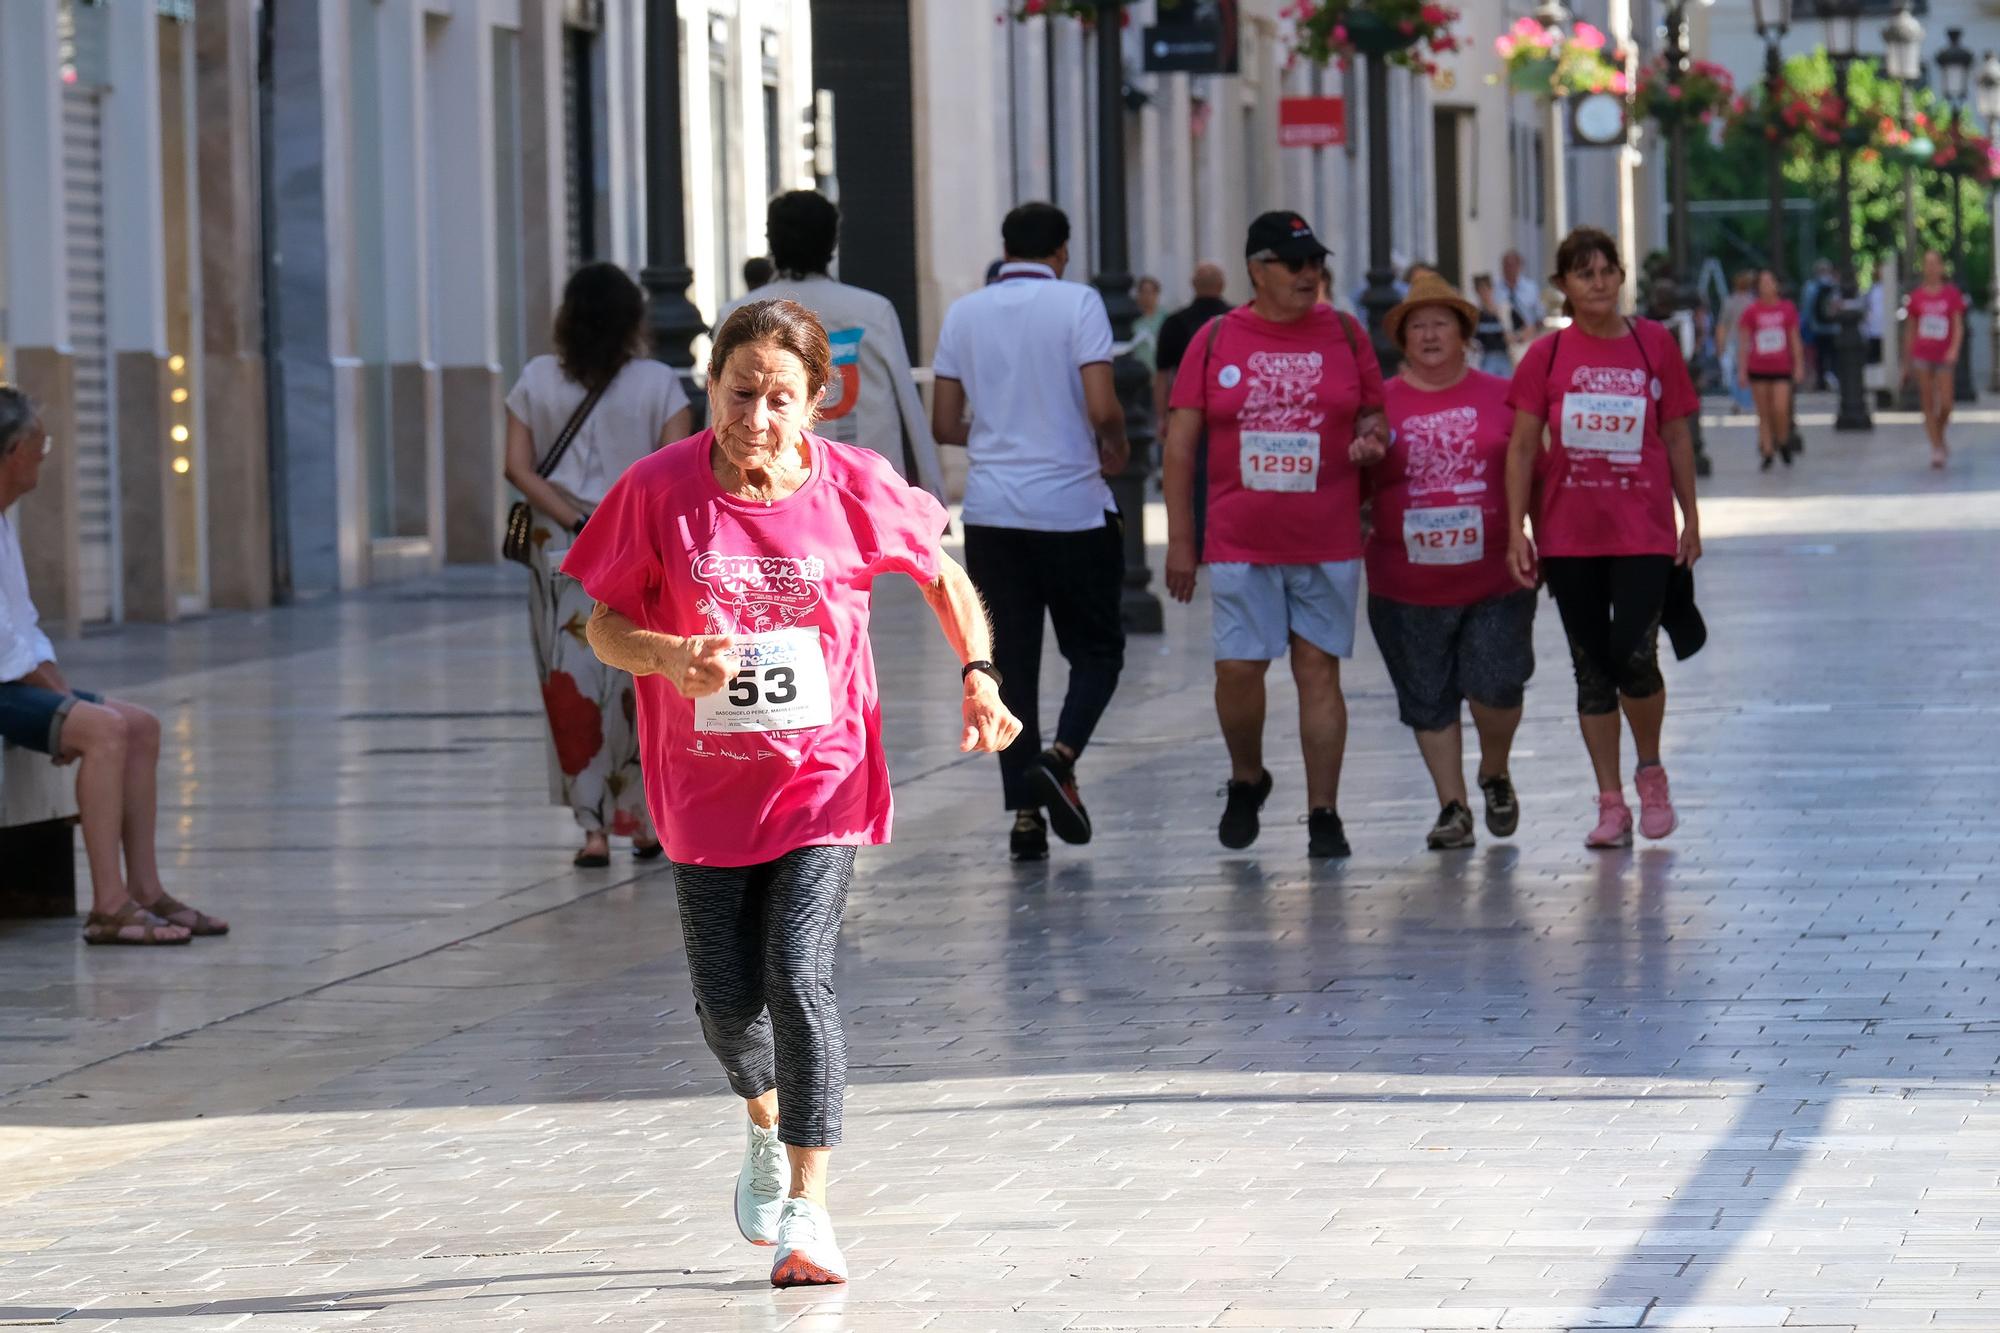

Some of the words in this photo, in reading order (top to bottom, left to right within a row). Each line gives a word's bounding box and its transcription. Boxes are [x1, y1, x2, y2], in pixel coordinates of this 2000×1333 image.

[1571, 413, 1637, 434] 1337
[1248, 454, 1313, 474] 1299
[1413, 528, 1478, 548] 1279
[699, 556, 802, 577] Carrera
[728, 667, 797, 707] 53
